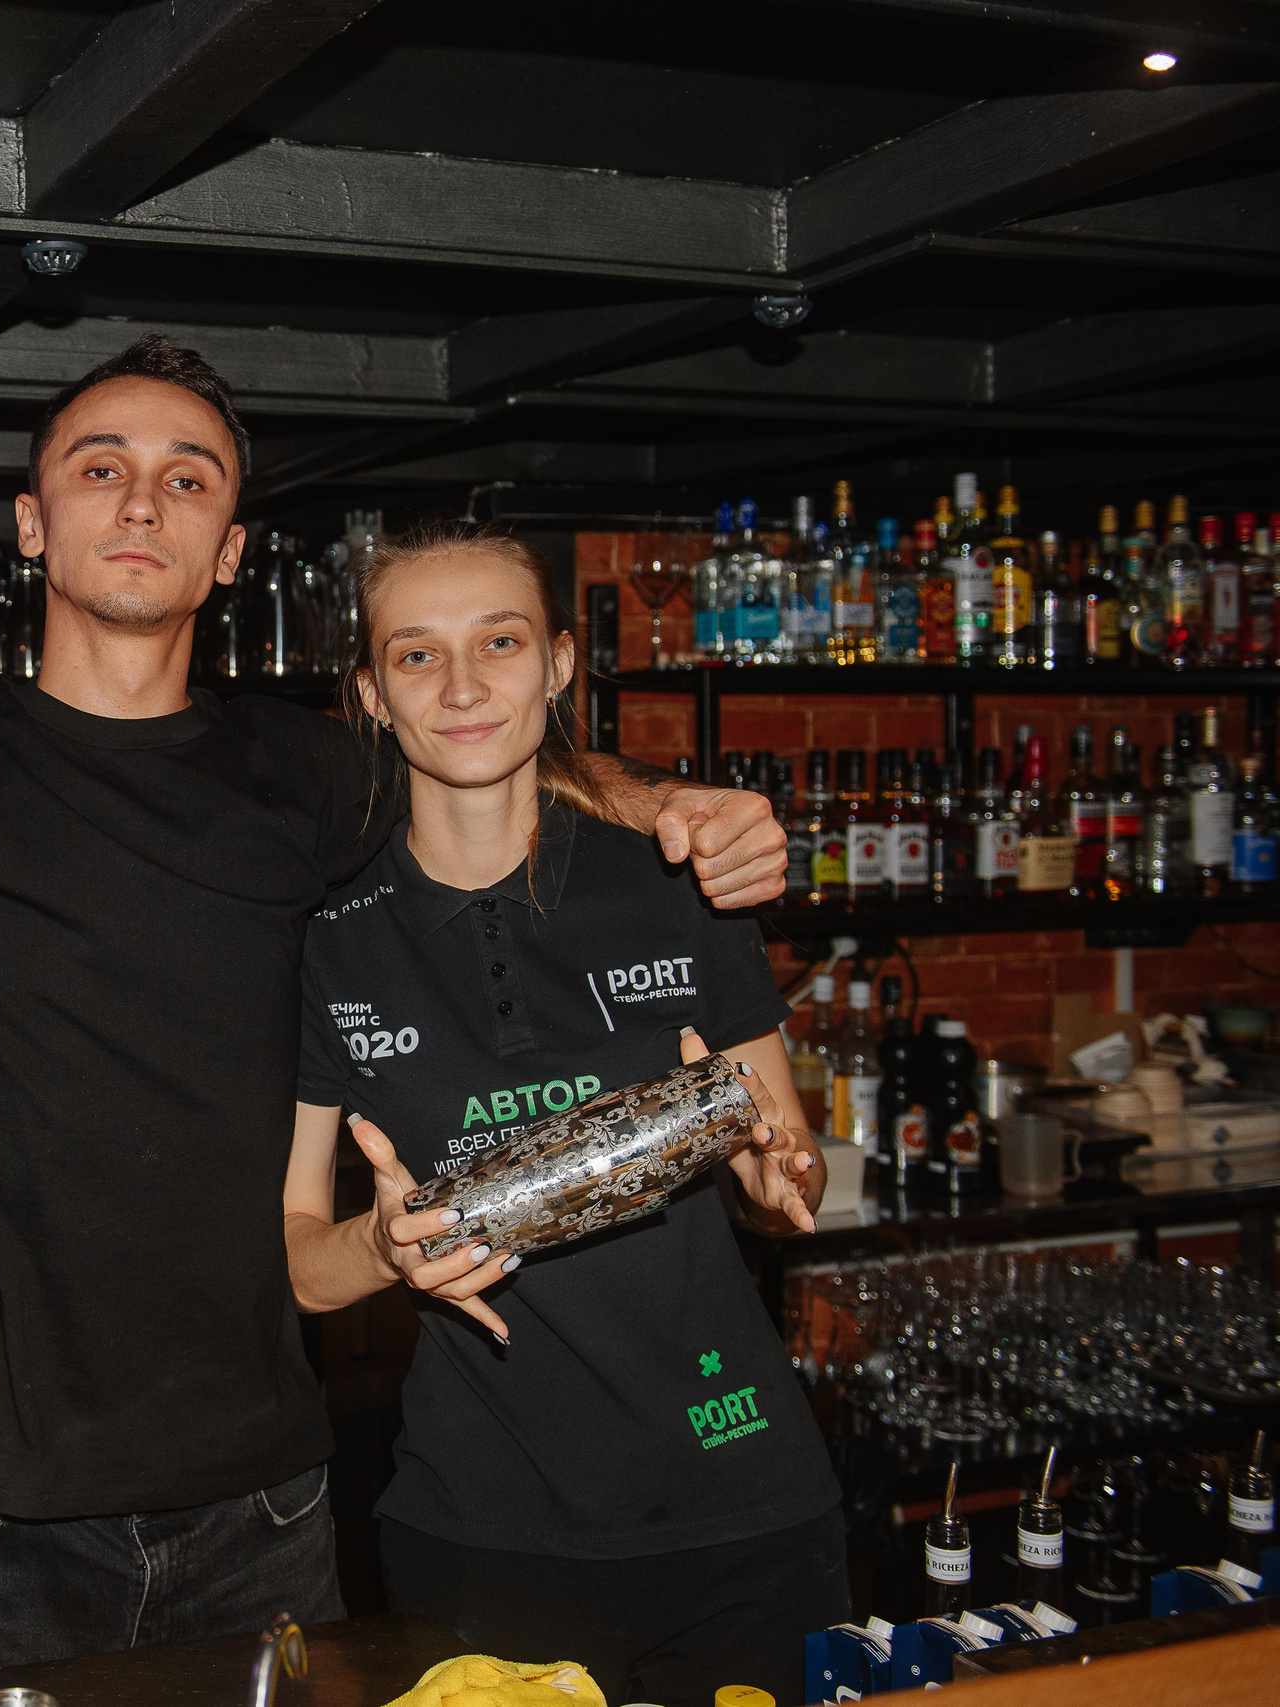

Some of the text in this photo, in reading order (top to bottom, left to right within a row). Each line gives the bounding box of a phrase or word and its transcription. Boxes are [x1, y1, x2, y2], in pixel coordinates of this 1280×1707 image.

[607, 957, 694, 995] PORT
[613, 986, 697, 1003] СТЕЙК-РЕСТОРАН
[333, 1015, 366, 1029] УШИ
[462, 1074, 602, 1129] АВТОР
[447, 1130, 497, 1155] ВСЕХ
[687, 1386, 758, 1437] PORT
[701, 1417, 769, 1450] СТЕЙК-РЕСТОРАН
